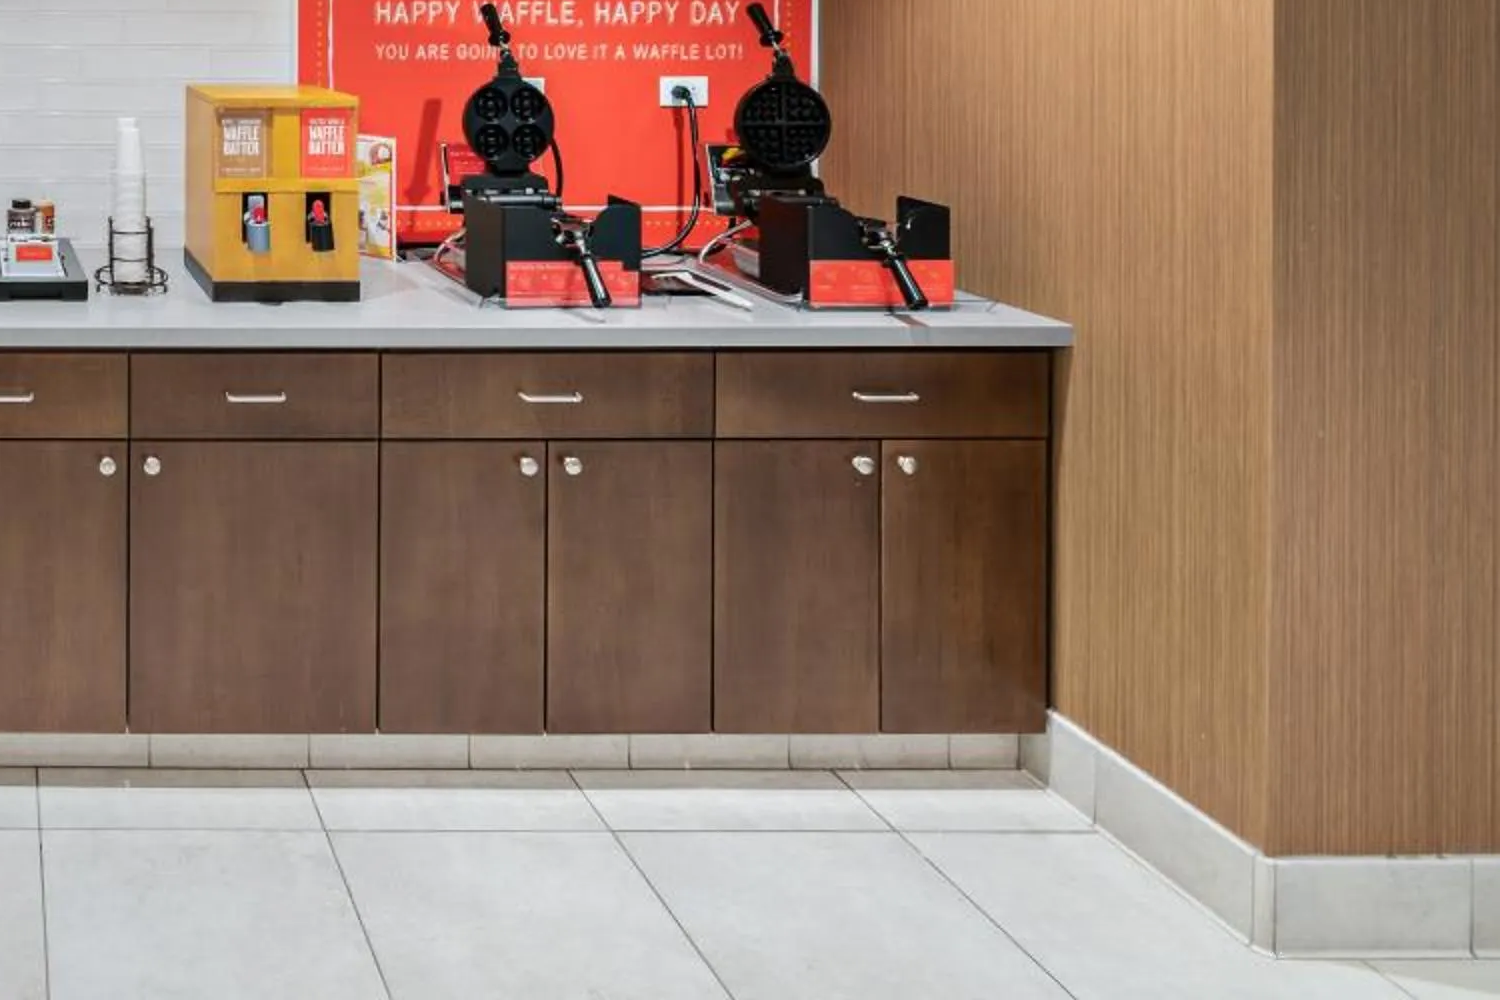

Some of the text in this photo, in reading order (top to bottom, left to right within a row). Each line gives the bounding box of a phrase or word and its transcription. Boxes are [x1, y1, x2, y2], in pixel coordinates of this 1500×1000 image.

[375, 0, 461, 25] HAPPY
[594, 0, 680, 25] HAPPY
[690, 0, 740, 25] DAY
[375, 43, 743, 61] YOU ARE GOIN TO LOVE IT A WAFFLE LOT!
[224, 125, 260, 140] WAFFLE
[309, 125, 345, 141] WAFFLE
